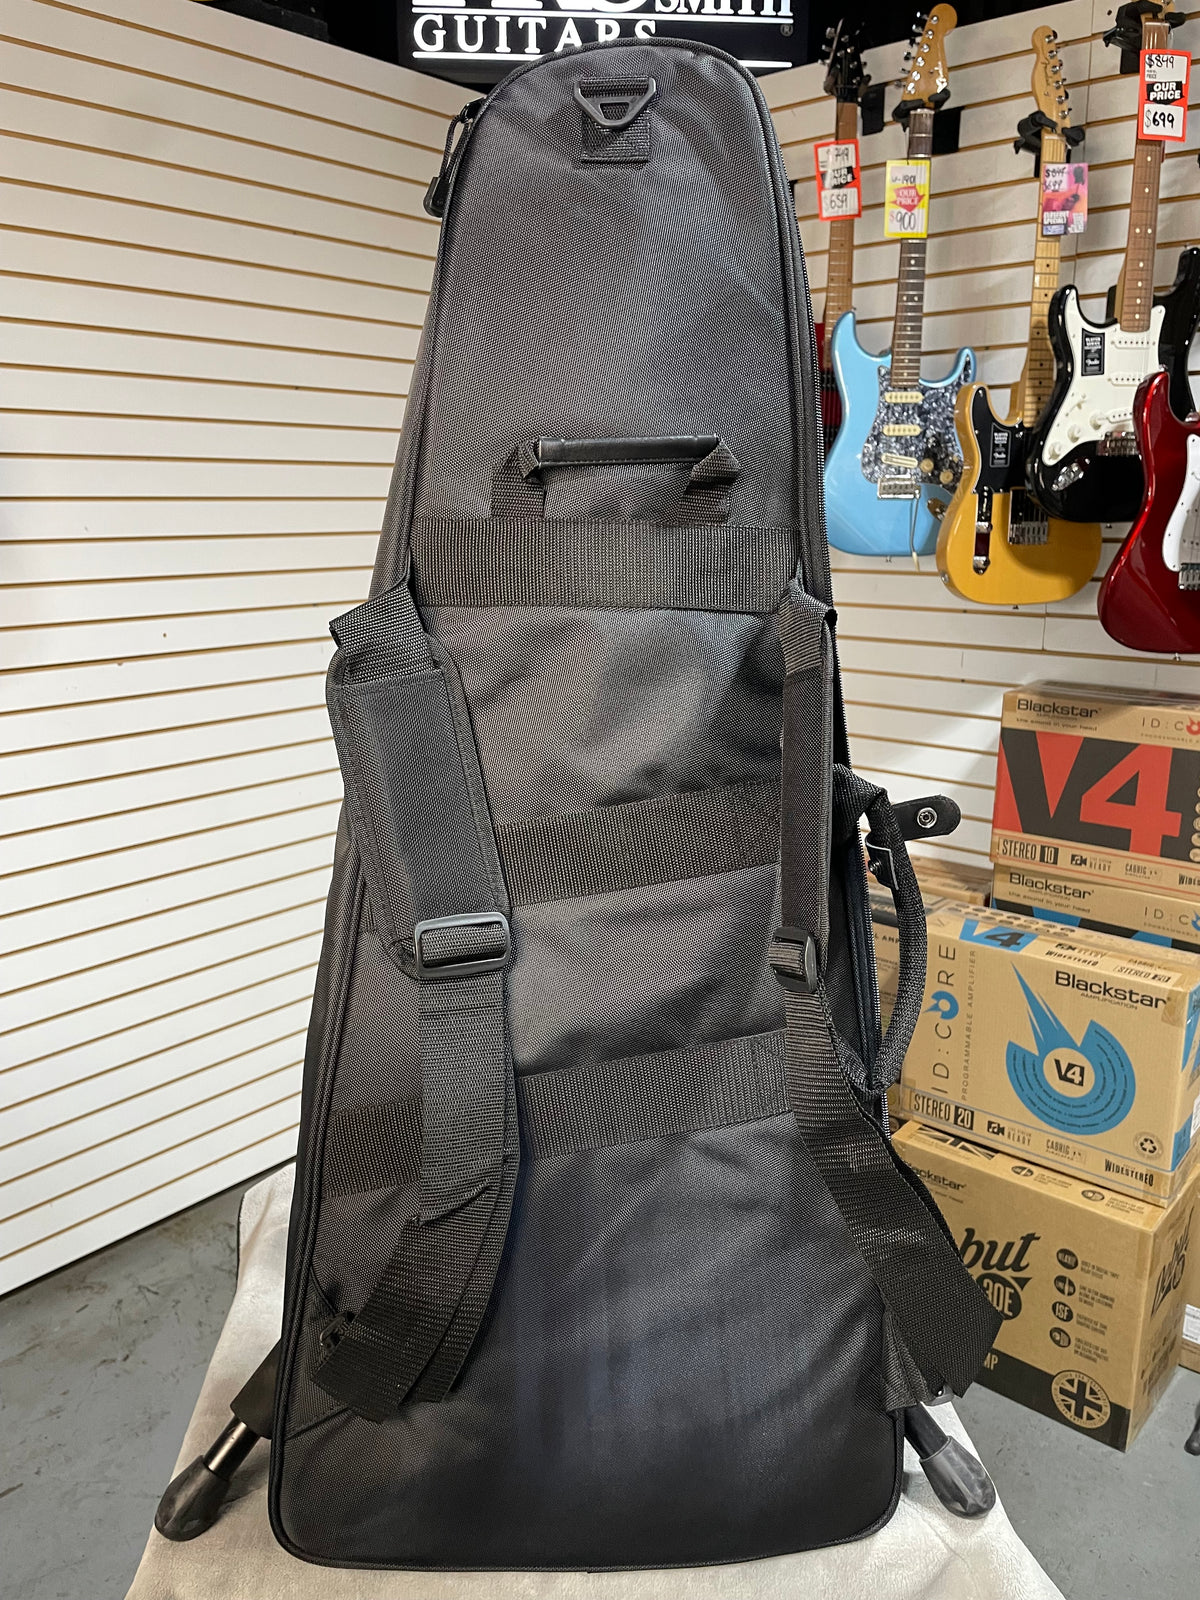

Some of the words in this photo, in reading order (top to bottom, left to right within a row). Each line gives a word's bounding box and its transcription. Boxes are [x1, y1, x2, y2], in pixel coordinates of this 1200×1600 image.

[1146, 53, 1175, 69] $849
[1149, 90, 1181, 101] PRICE
[1153, 82, 1177, 92] OUR
[1145, 109, 1175, 129] $699
[896, 197, 919, 206] PRICE
[899, 188, 917, 198] OUR
[889, 211, 916, 231] $900
[1017, 698, 1098, 718] Blackstar
[1001, 727, 1182, 858] V4
[1002, 838, 1037, 861] STEREO
[1042, 846, 1056, 864] 10
[1009, 872, 1092, 899] Blackstar
[959, 918, 1039, 953] V4
[967, 950, 976, 1008] AMPLIFIER
[1055, 970, 1167, 1009] Blackstar
[1080, 992, 1138, 1011] AMPLIFICATION
[961, 1012, 974, 1101] PROGRAMMABLE
[1054, 1058, 1085, 1087] V4
[914, 1094, 951, 1121] STEREO
[956, 1107, 973, 1129] 20
[1104, 1158, 1154, 1187] WIDESTEREO
[1055, 1302, 1069, 1320] ISF
